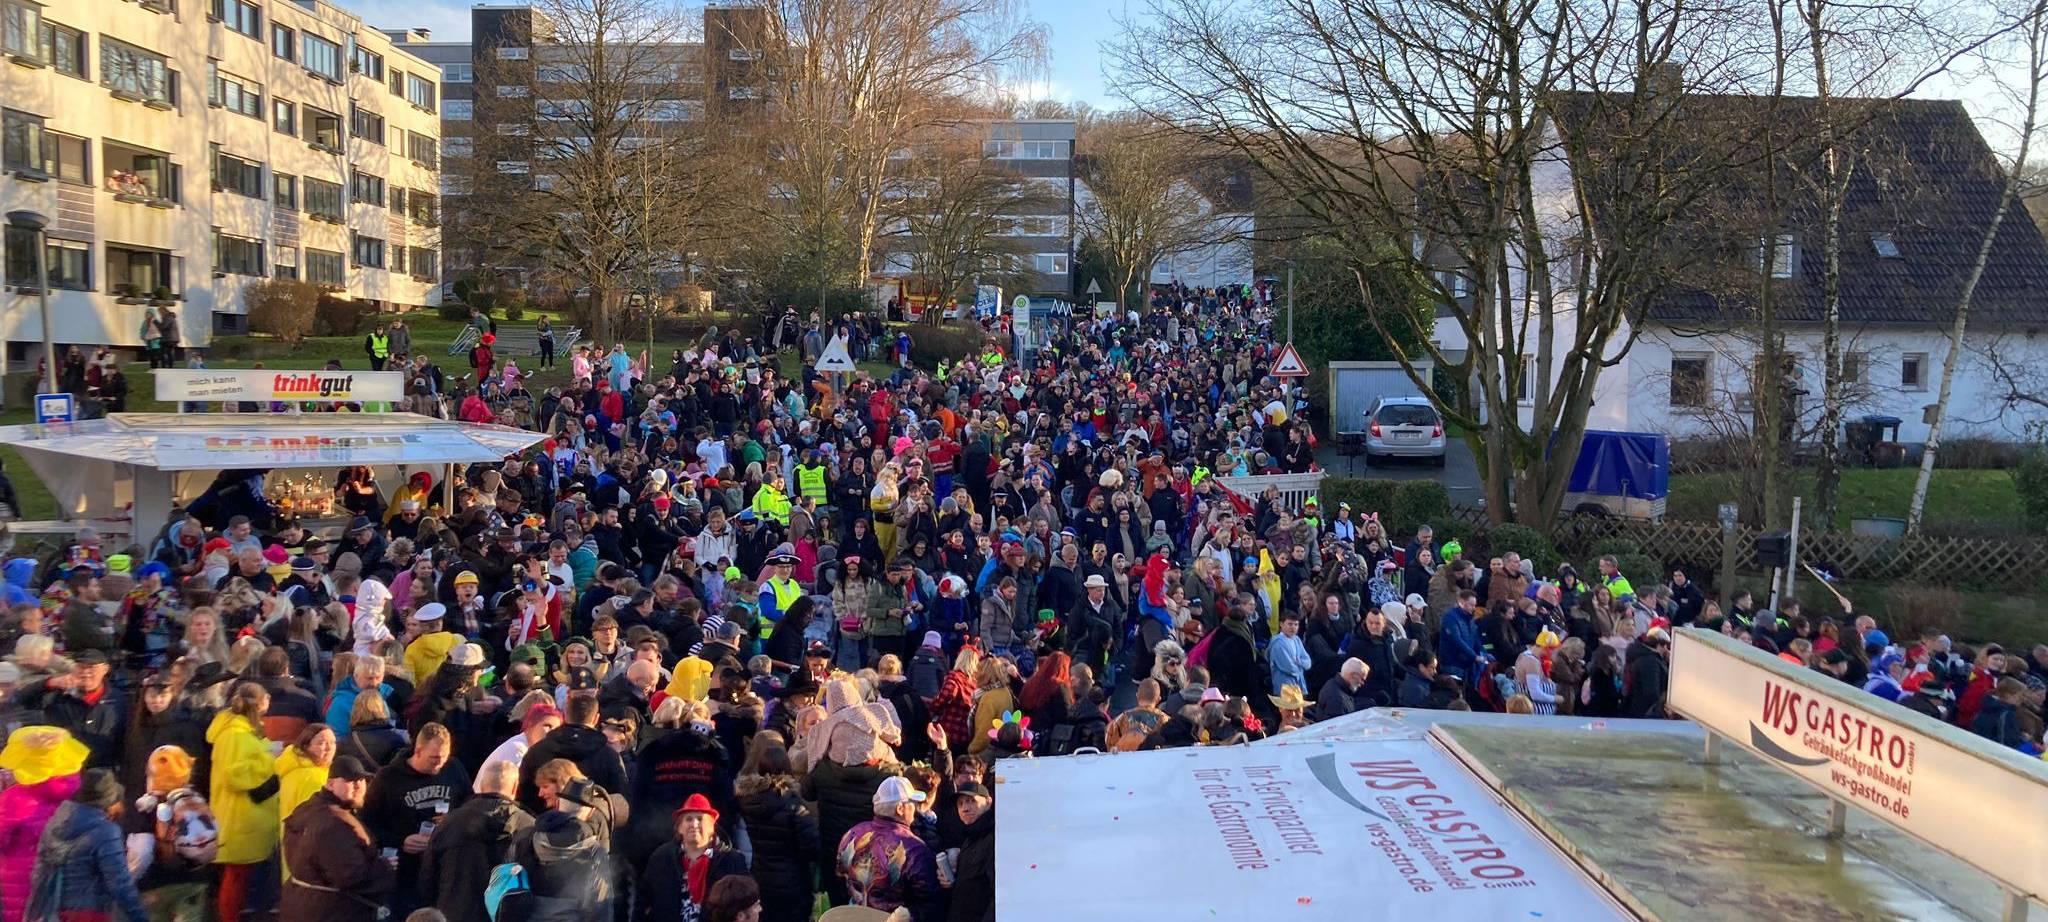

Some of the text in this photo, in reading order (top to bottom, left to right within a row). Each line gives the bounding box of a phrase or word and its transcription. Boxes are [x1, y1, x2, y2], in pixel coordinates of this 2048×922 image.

[186, 376, 236, 385] mich kann
[211, 386, 243, 395] mieten
[274, 373, 353, 397] trinkgut
[1763, 681, 1906, 769] WS GASTRO
[1803, 731, 1911, 796] Getränkefachgroßhandel
[1831, 769, 1909, 818] ws-gastro.de
[1192, 768, 1269, 869] für die Gastronomie
[1242, 765, 1323, 855] Ihr Servicepartner
[1350, 760, 1524, 879] WS GASTRO
[1365, 822, 1437, 893] ws-gastro.de
[1483, 879, 1536, 889] GmbH
